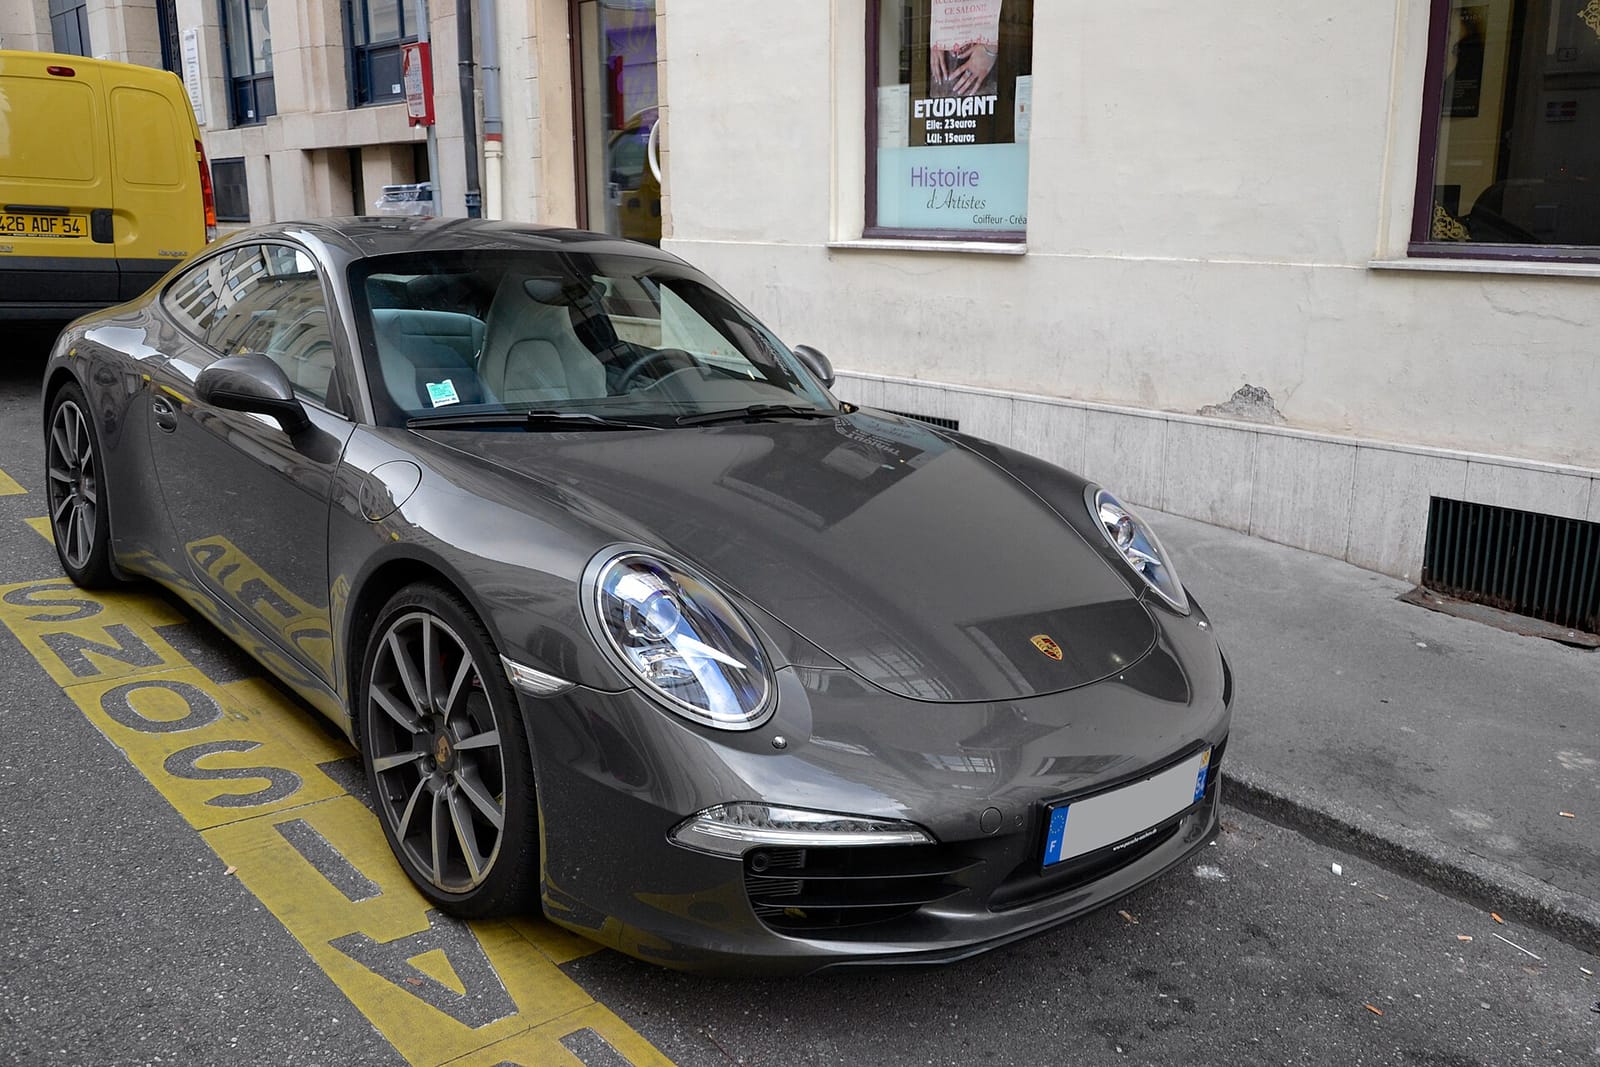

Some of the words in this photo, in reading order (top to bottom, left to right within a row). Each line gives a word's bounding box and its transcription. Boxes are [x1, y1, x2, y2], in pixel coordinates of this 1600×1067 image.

[914, 95, 998, 119] ETUDIANT
[911, 166, 980, 188] Histoire
[32, 217, 58, 233] ADF
[62, 218, 81, 234] 54
[973, 214, 1003, 225] Coiffeur
[1049, 840, 1057, 853] F
